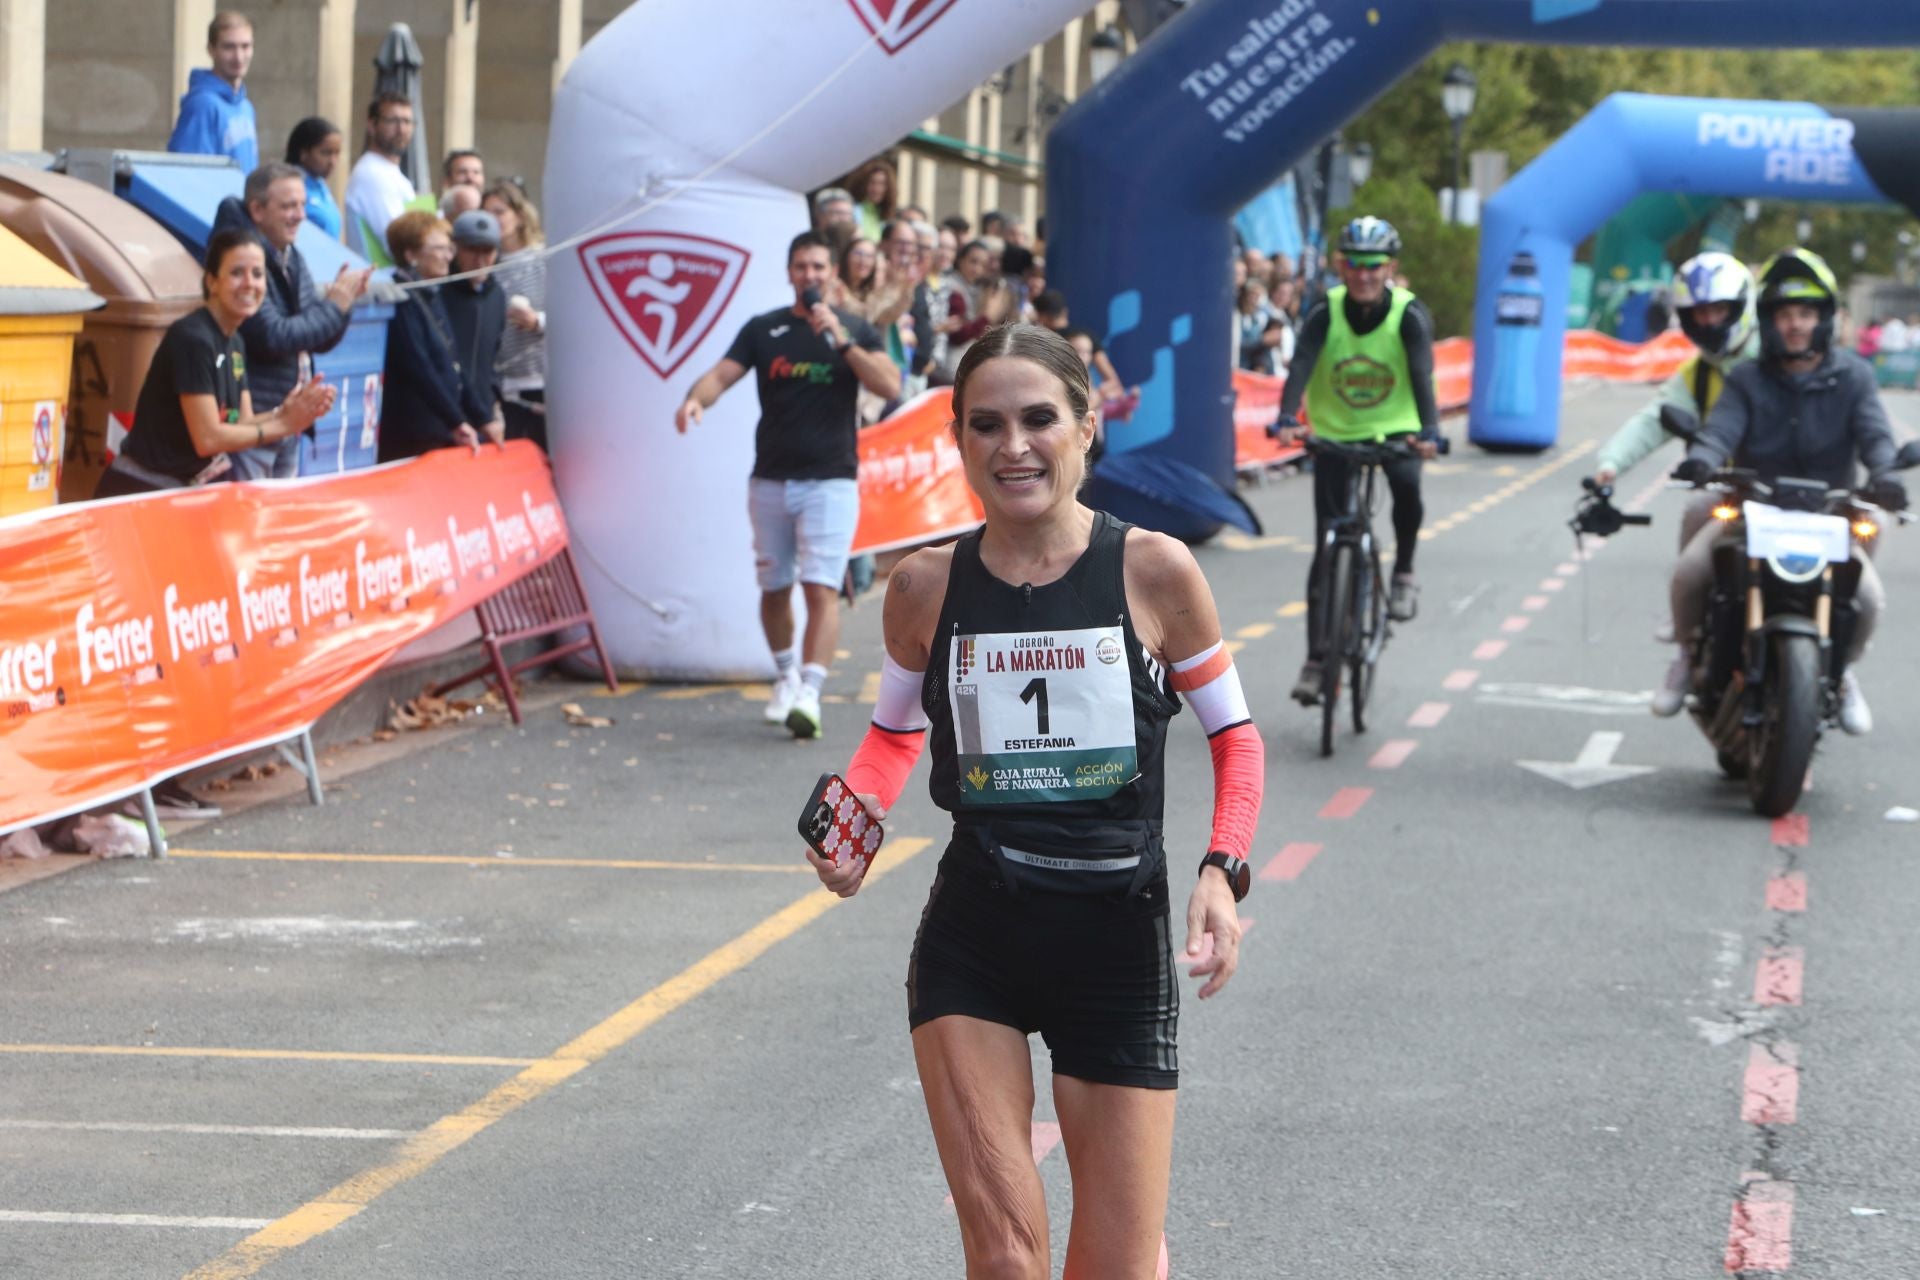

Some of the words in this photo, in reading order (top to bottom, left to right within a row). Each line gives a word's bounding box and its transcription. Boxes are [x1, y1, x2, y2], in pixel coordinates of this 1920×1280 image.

[1180, 62, 1228, 99] Tu
[1206, 12, 1331, 121] nuestra
[1222, 36, 1356, 143] vocación.
[1698, 112, 1855, 151] POWER
[299, 554, 348, 626] ferrer
[356, 539, 403, 611] ferrer
[164, 583, 229, 662] ferrer
[237, 568, 291, 643] ferrer
[76, 602, 153, 685] ferrer
[987, 651, 1005, 672] LA
[1011, 645, 1085, 672] MARATÓN
[1014, 636, 1054, 649] LOGROÑO
[956, 685, 976, 695] 42K
[1019, 677, 1049, 735] 1
[1004, 737, 1075, 750] ESTEFANIA
[993, 768, 1022, 780] CAJA
[1023, 766, 1064, 779] RURAL
[994, 780, 1009, 791] DE
[1012, 777, 1071, 791] NAVARRA
[1075, 761, 1123, 774] ACCIÓN
[1075, 776, 1123, 787] SOCIAL
[1025, 854, 1070, 868] ULTIMATE
